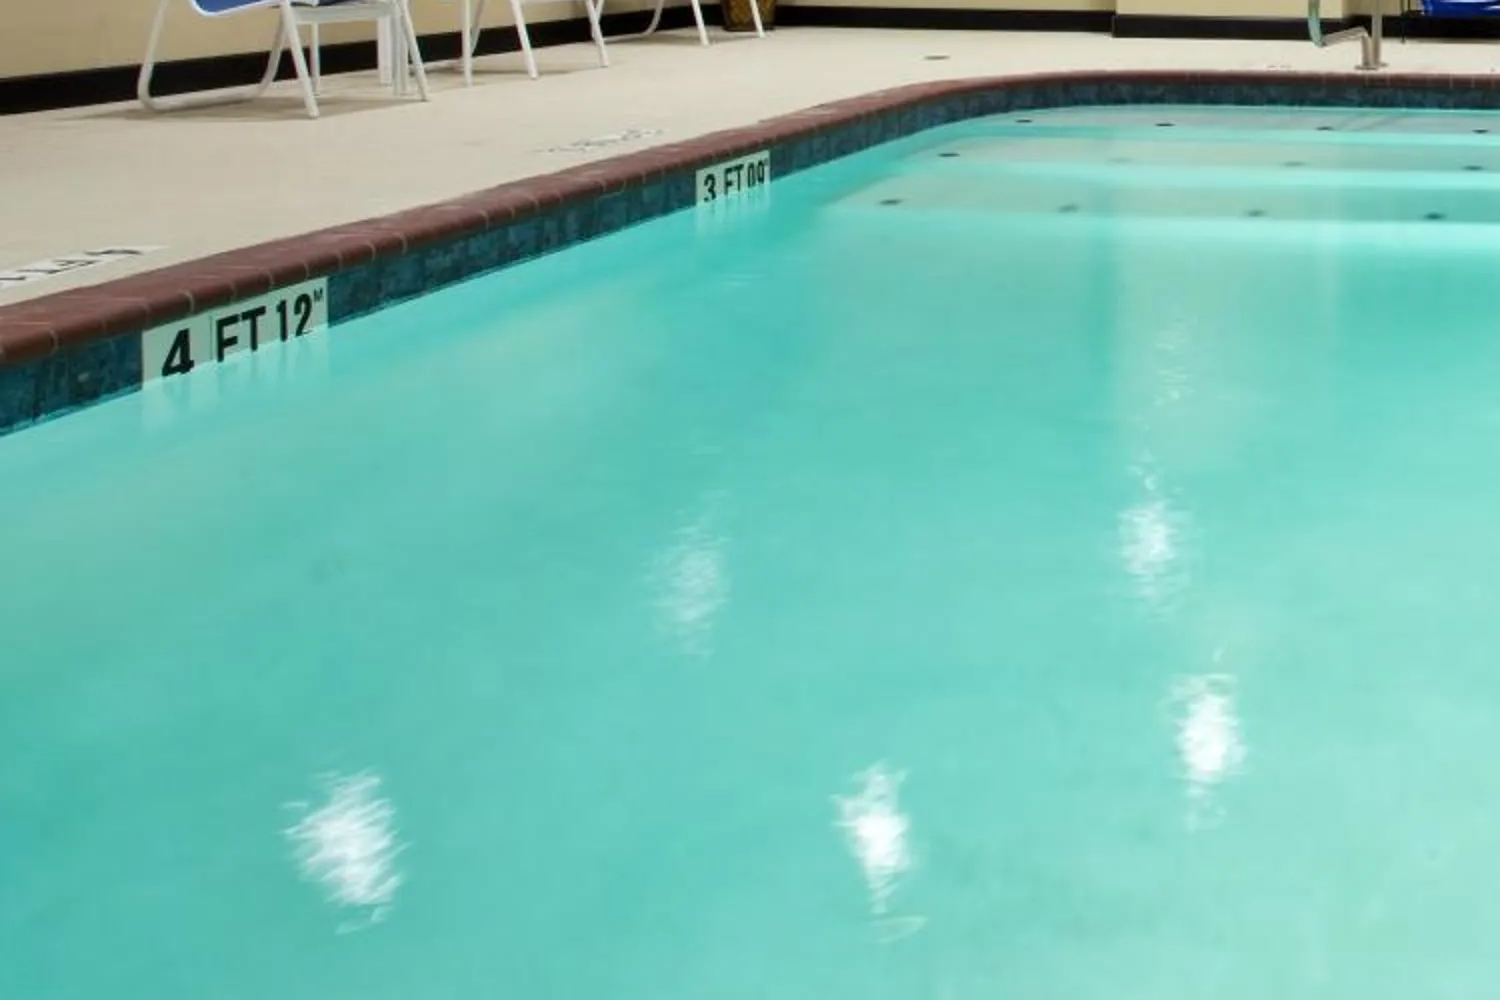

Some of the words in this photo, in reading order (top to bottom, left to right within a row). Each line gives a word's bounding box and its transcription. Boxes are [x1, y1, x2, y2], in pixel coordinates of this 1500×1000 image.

[704, 173, 717, 202] 3
[724, 163, 745, 196] FT
[162, 327, 195, 377] 4
[216, 305, 267, 363] FT
